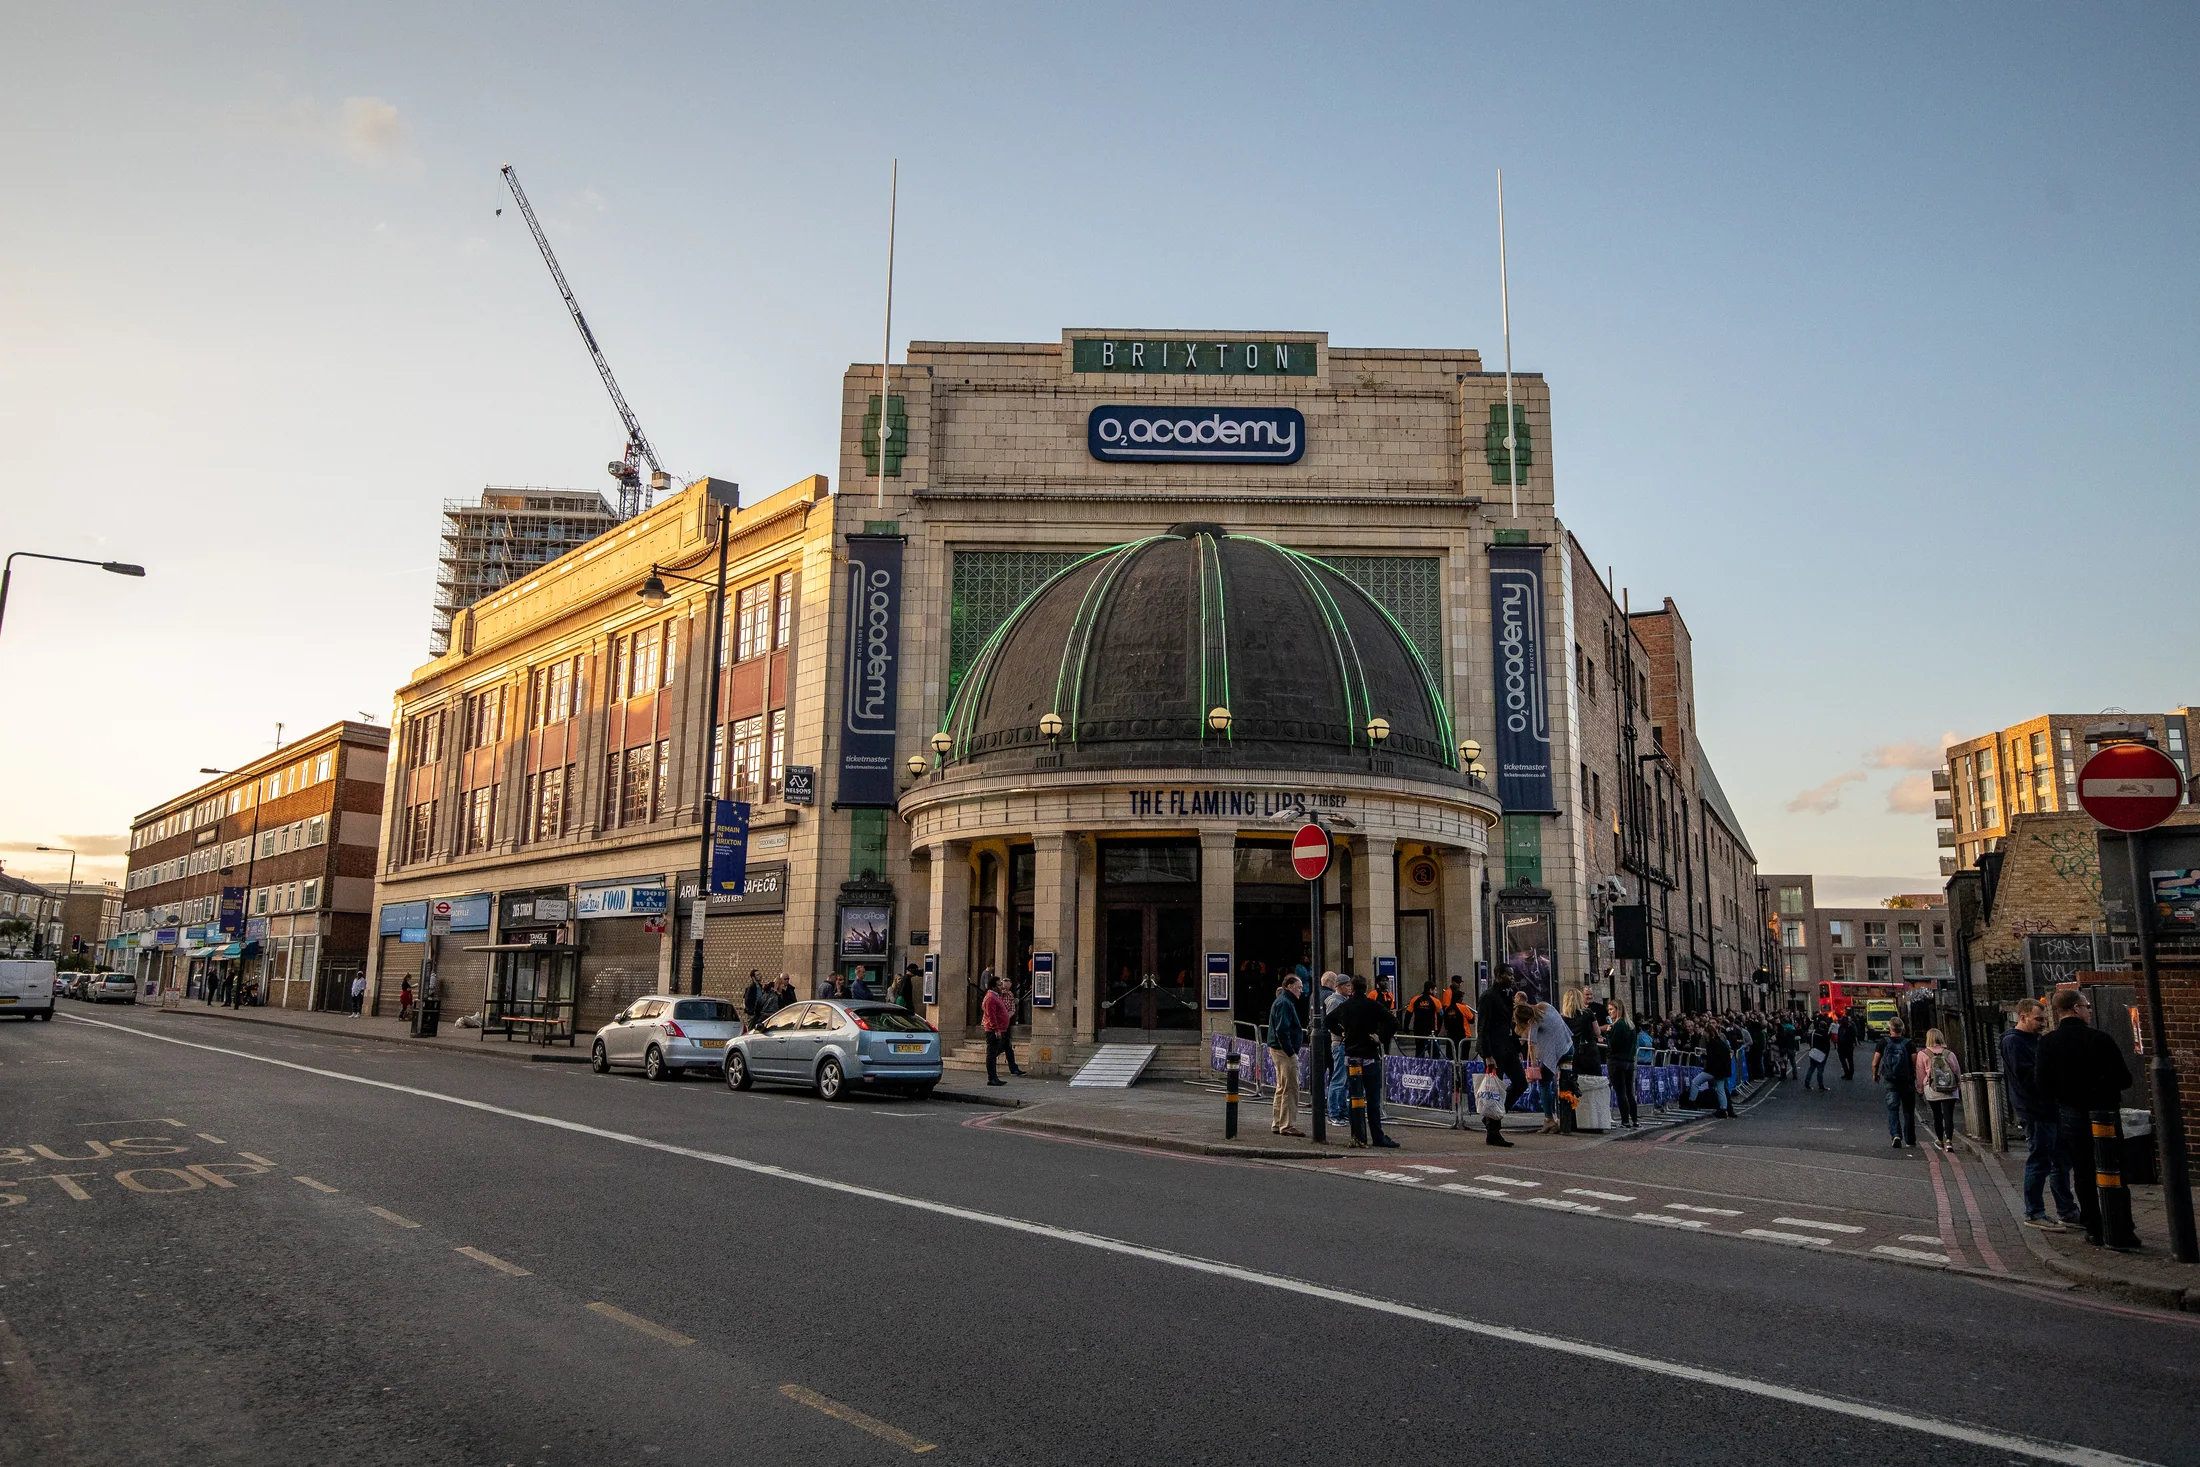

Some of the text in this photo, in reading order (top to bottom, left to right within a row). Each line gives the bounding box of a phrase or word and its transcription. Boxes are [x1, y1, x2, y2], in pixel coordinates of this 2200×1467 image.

[1103, 342, 1288, 370] BRIXTON
[846, 755, 889, 763] ticketmaster
[1503, 763, 1546, 771] ticketmaster
[1129, 790, 1164, 815] THE
[1170, 790, 1256, 816] FLAMING
[1264, 792, 1306, 817] LIPS
[717, 825, 740, 833] REMAIN
[716, 838, 742, 846] BRIXTON
[601, 890, 626, 910] FOOD
